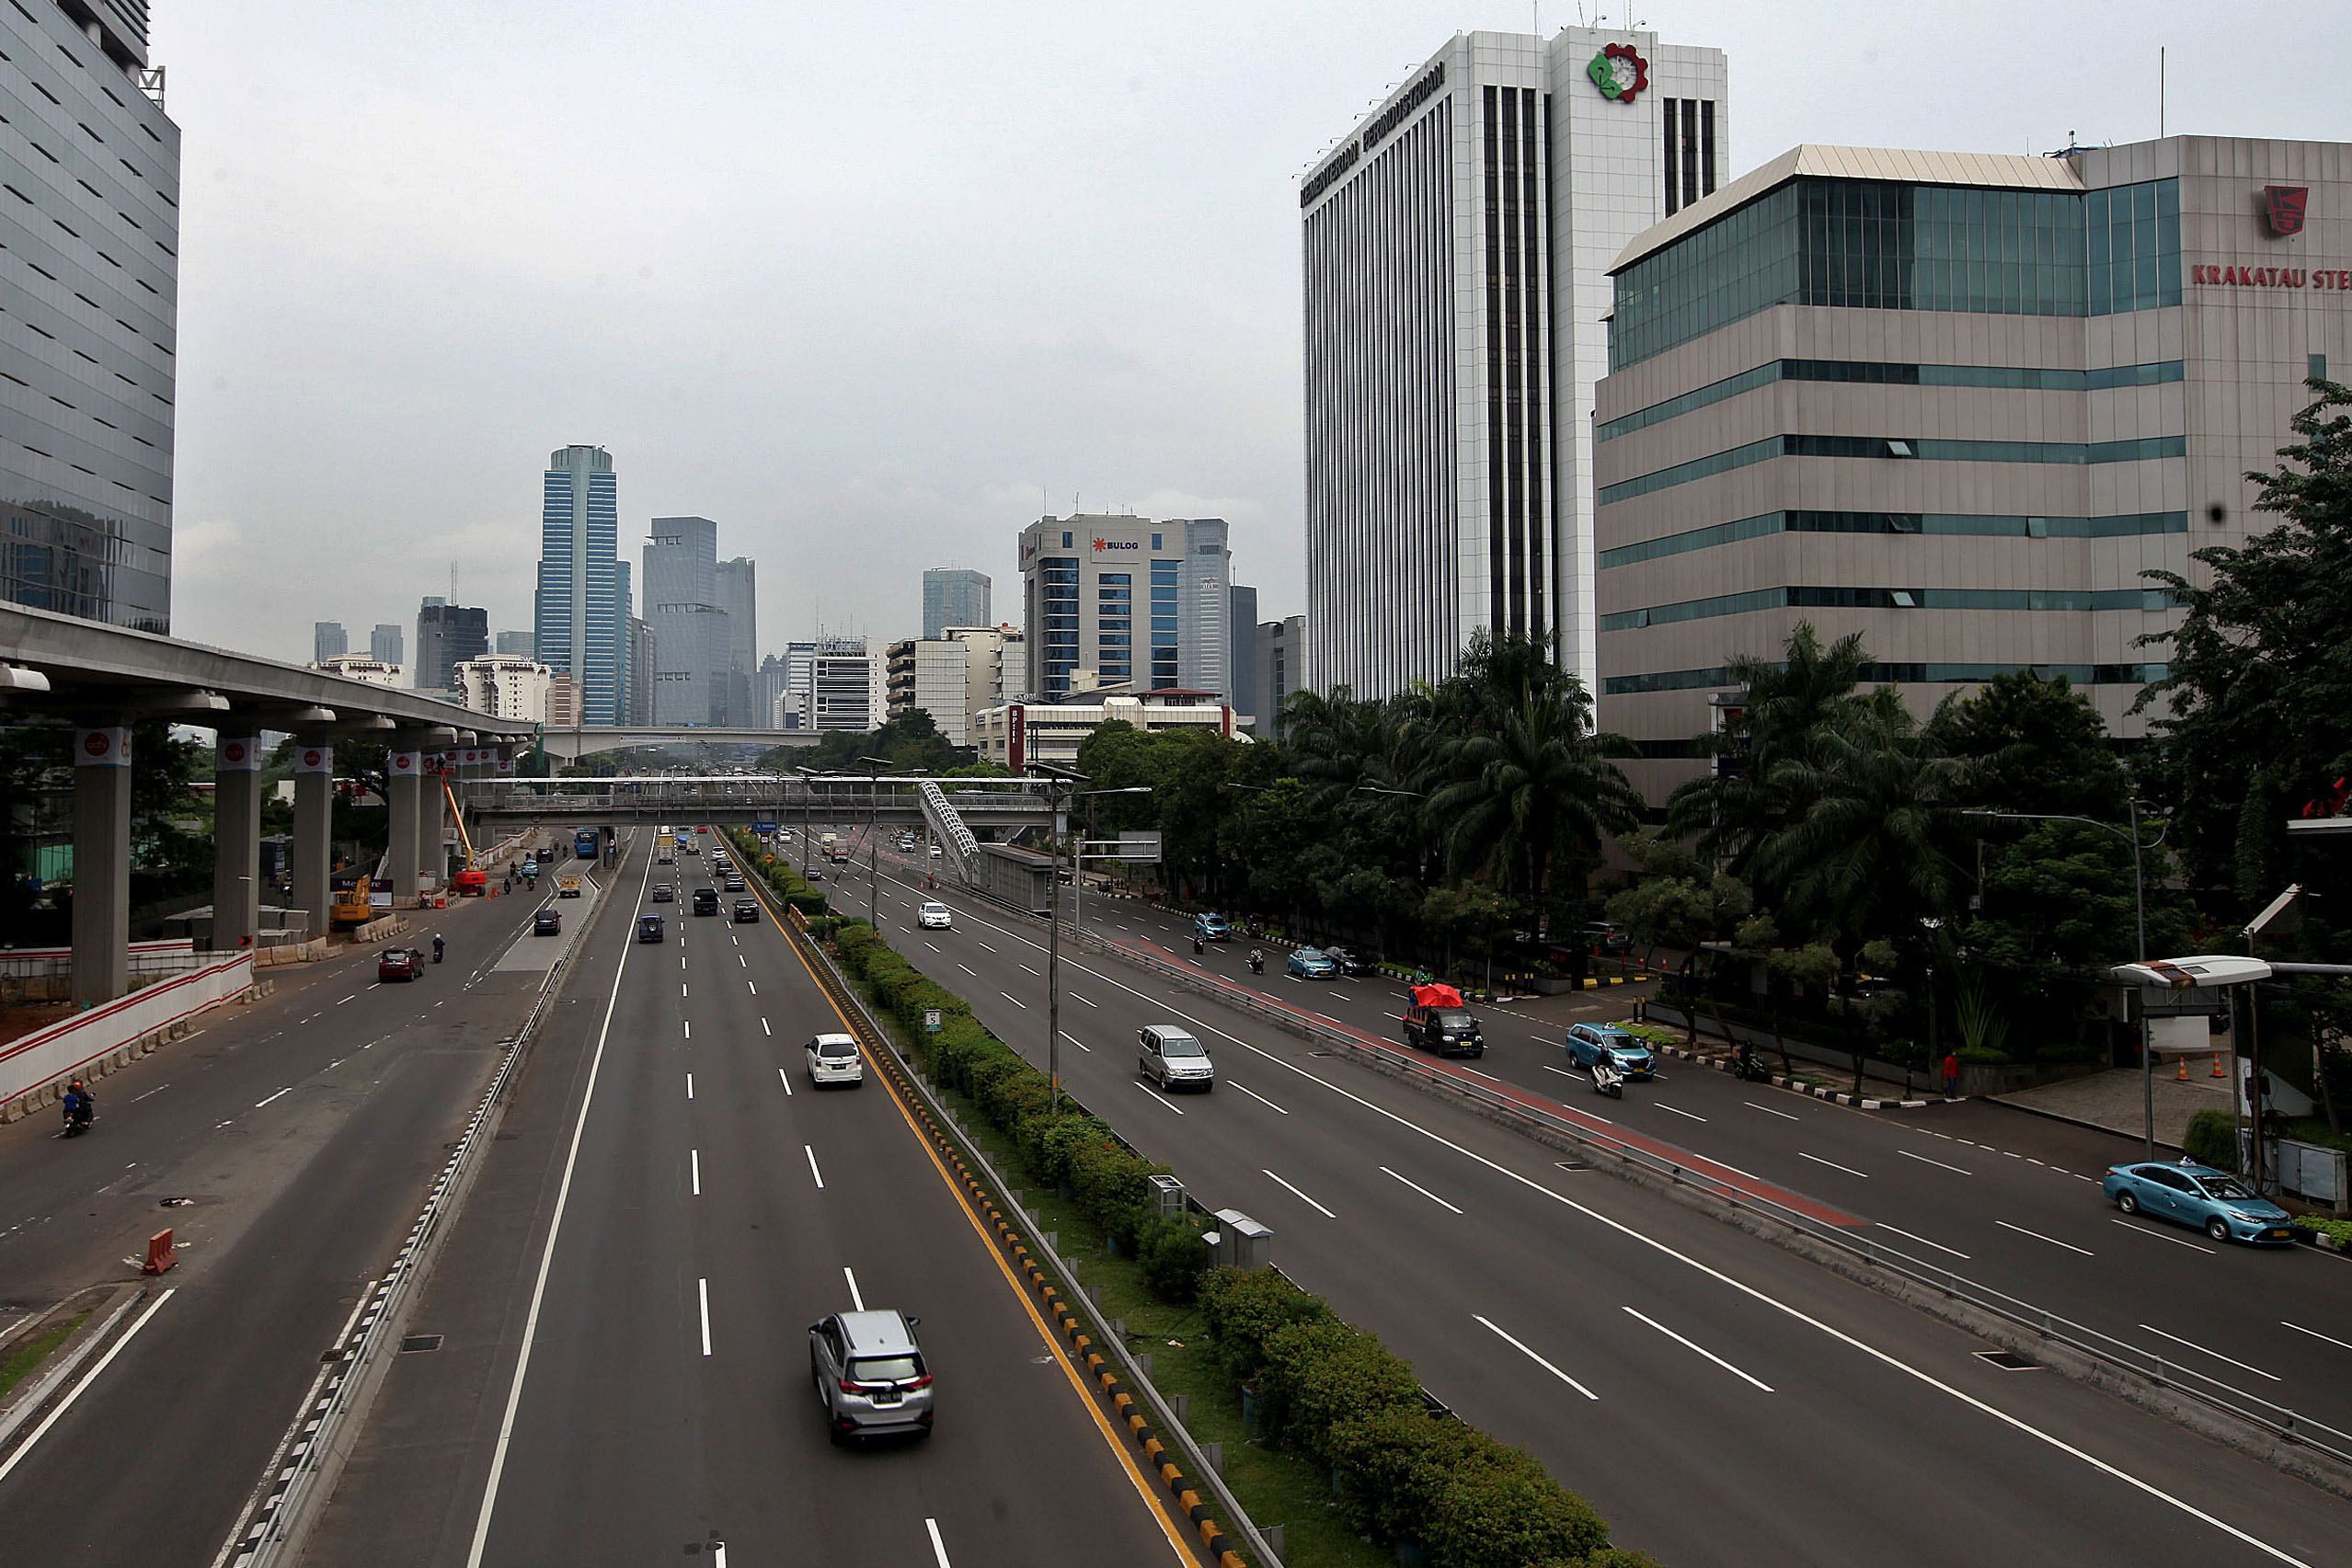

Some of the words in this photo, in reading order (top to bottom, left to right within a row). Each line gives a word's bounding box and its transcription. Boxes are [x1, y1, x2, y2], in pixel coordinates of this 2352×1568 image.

[1300, 140, 1360, 208] KEMENTERIAN
[1362, 61, 1445, 153] PERINDUSTRIAN
[2192, 264, 2307, 289] KRAKATAU
[2312, 269, 2352, 291] STE
[1107, 542, 1139, 550] BULOG
[342, 879, 382, 888] Mere
[930, 1016, 936, 1024] 5
